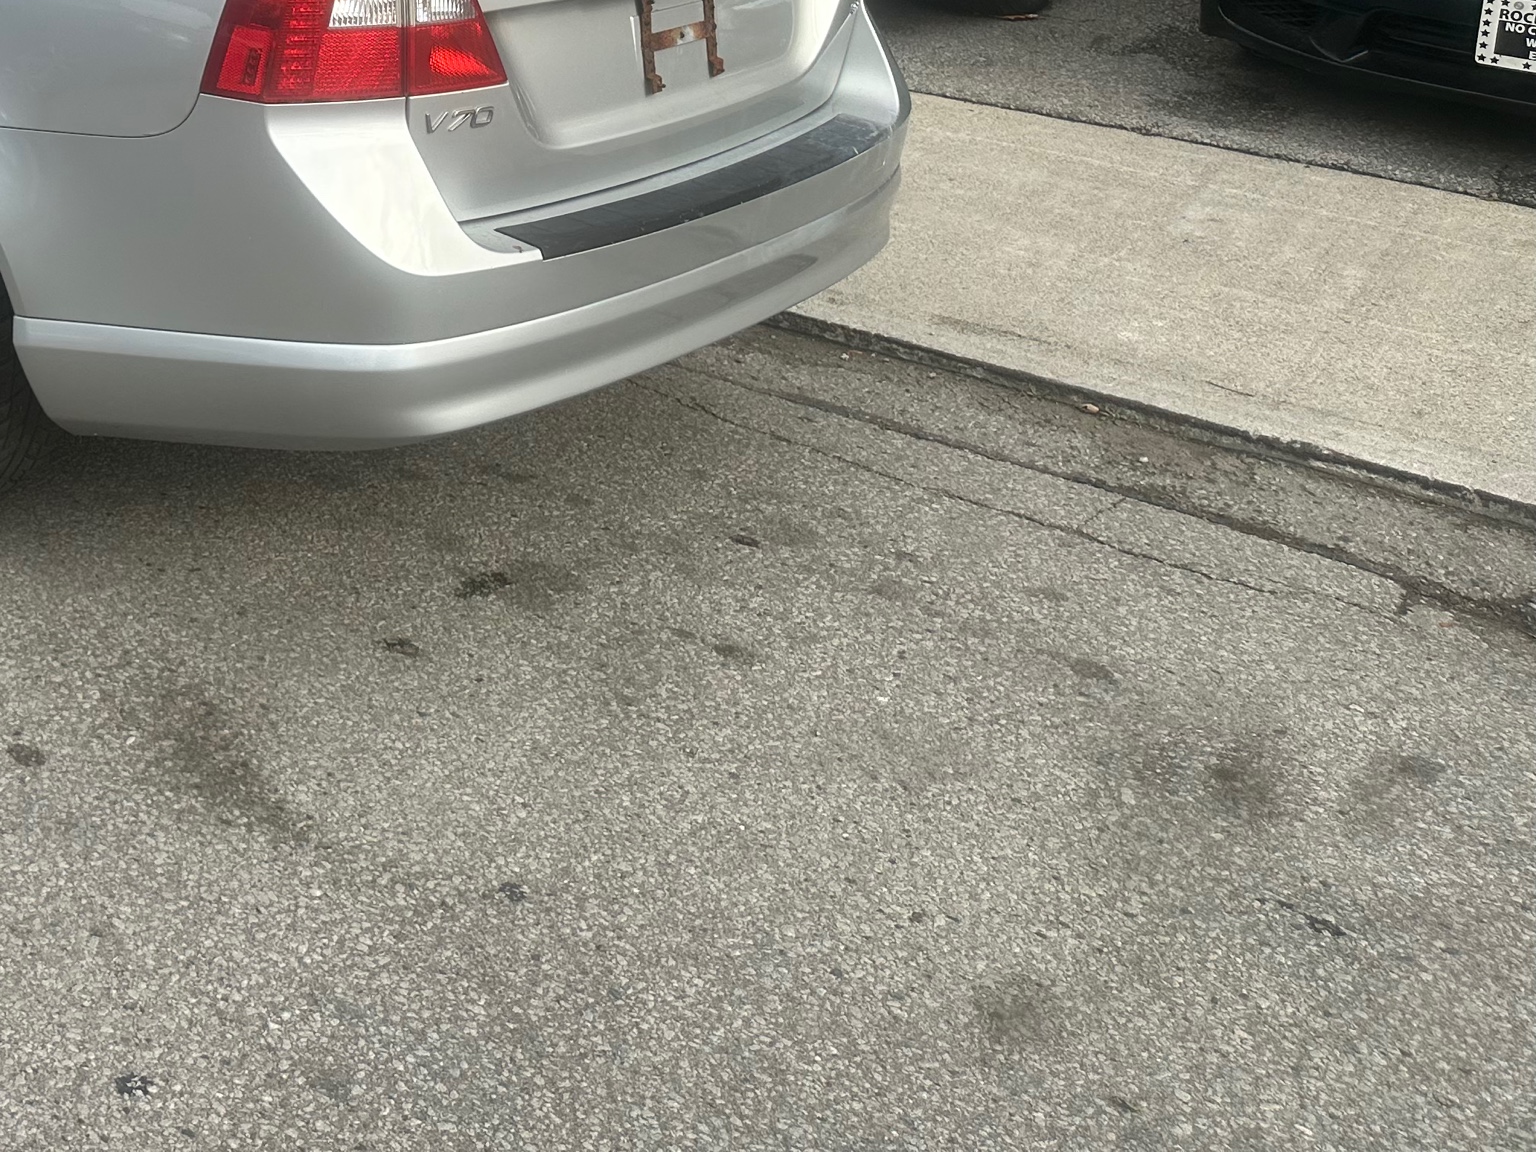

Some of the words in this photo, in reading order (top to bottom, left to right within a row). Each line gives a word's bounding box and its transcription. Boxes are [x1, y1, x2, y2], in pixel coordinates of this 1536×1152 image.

[1499, 9, 1536, 24] ROC
[1505, 22, 1525, 34] NO
[425, 106, 494, 134] V70
